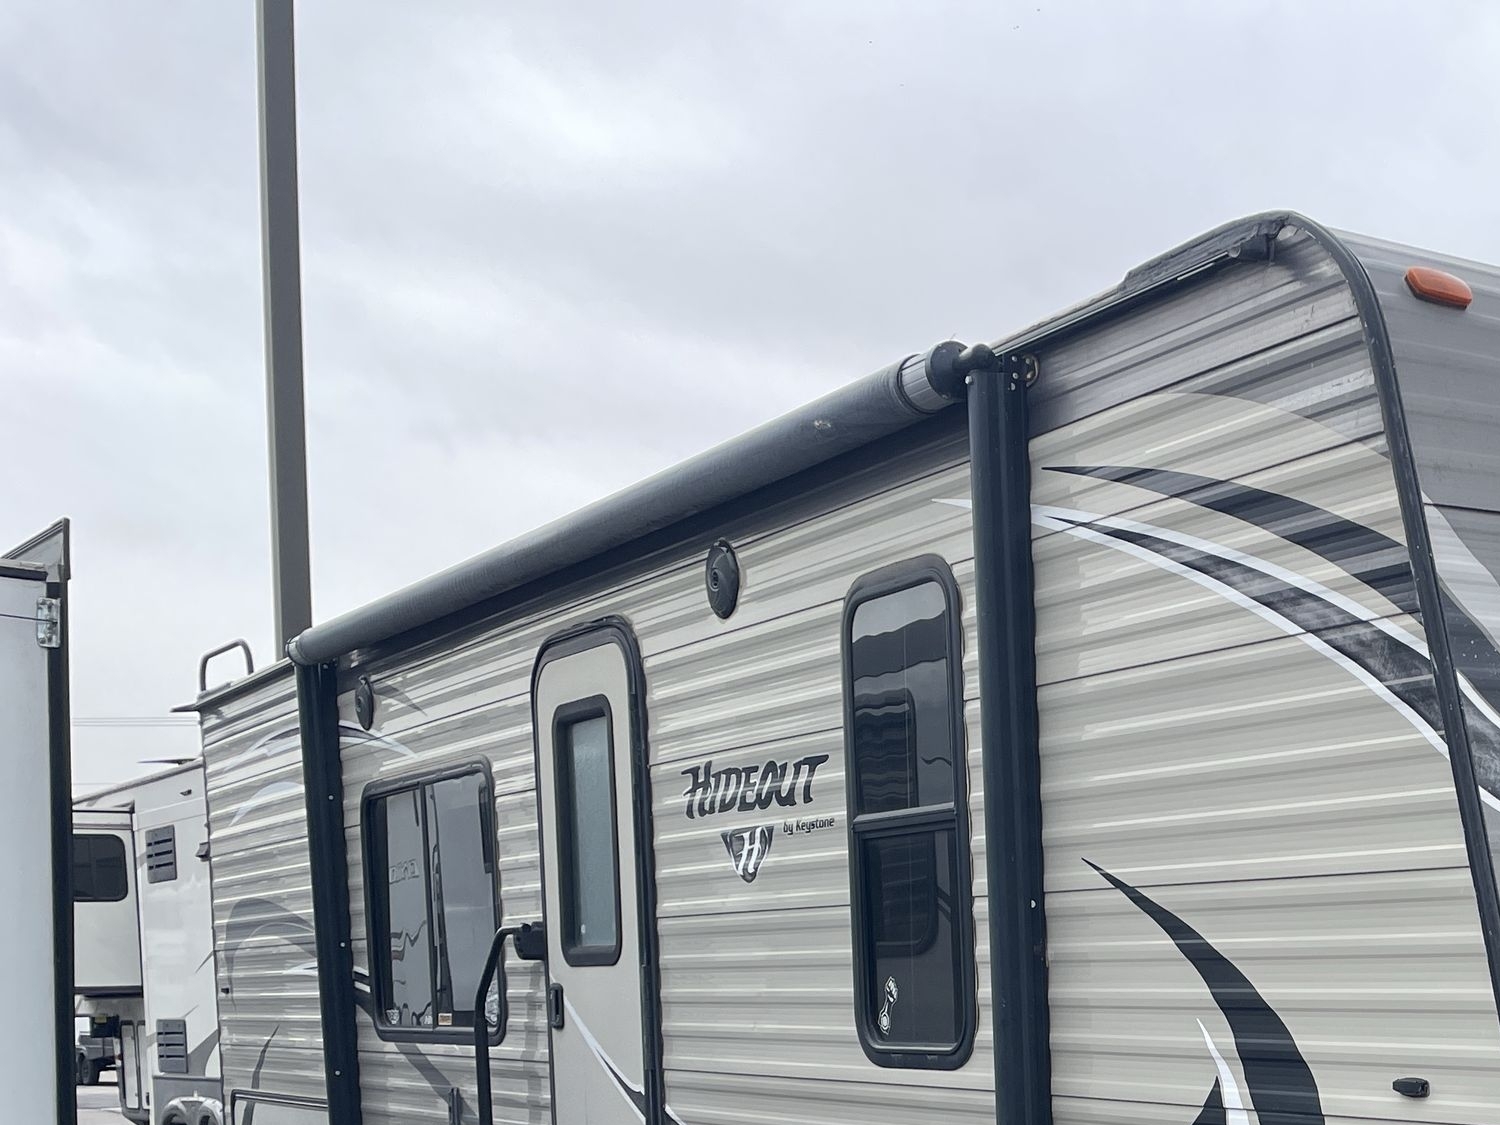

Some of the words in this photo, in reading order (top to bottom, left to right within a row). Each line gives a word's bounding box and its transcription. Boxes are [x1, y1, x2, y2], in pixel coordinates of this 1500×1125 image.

[681, 754, 830, 820] HIDEOUT
[783, 821, 794, 835] by
[795, 817, 835, 834] Keystone
